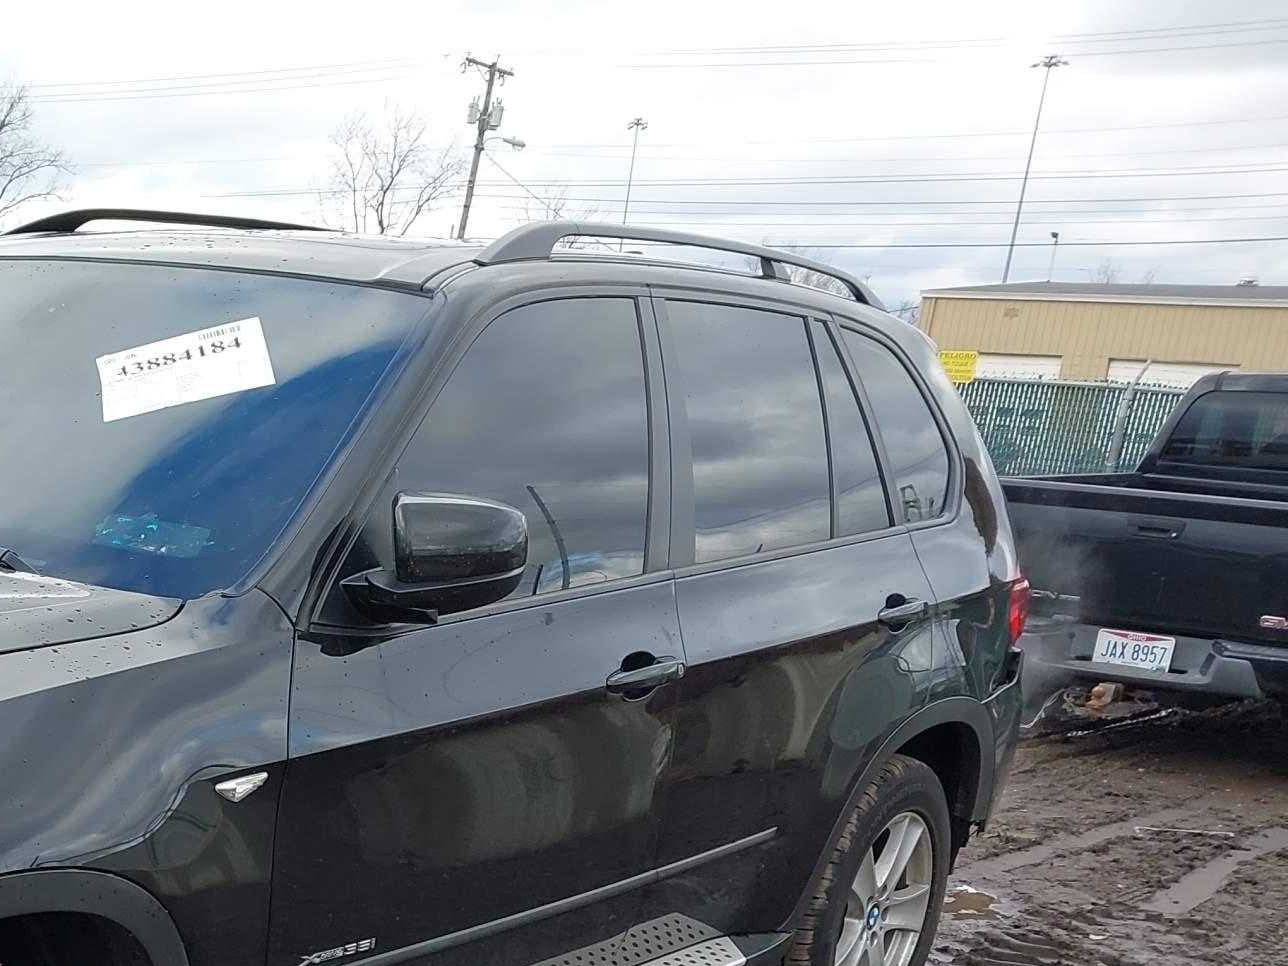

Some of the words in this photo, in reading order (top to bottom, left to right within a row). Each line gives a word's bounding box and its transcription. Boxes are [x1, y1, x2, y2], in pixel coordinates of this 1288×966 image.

[117, 336, 242, 377] 43884184
[1101, 639, 1128, 660] JAX
[1132, 643, 1168, 665] 8957
